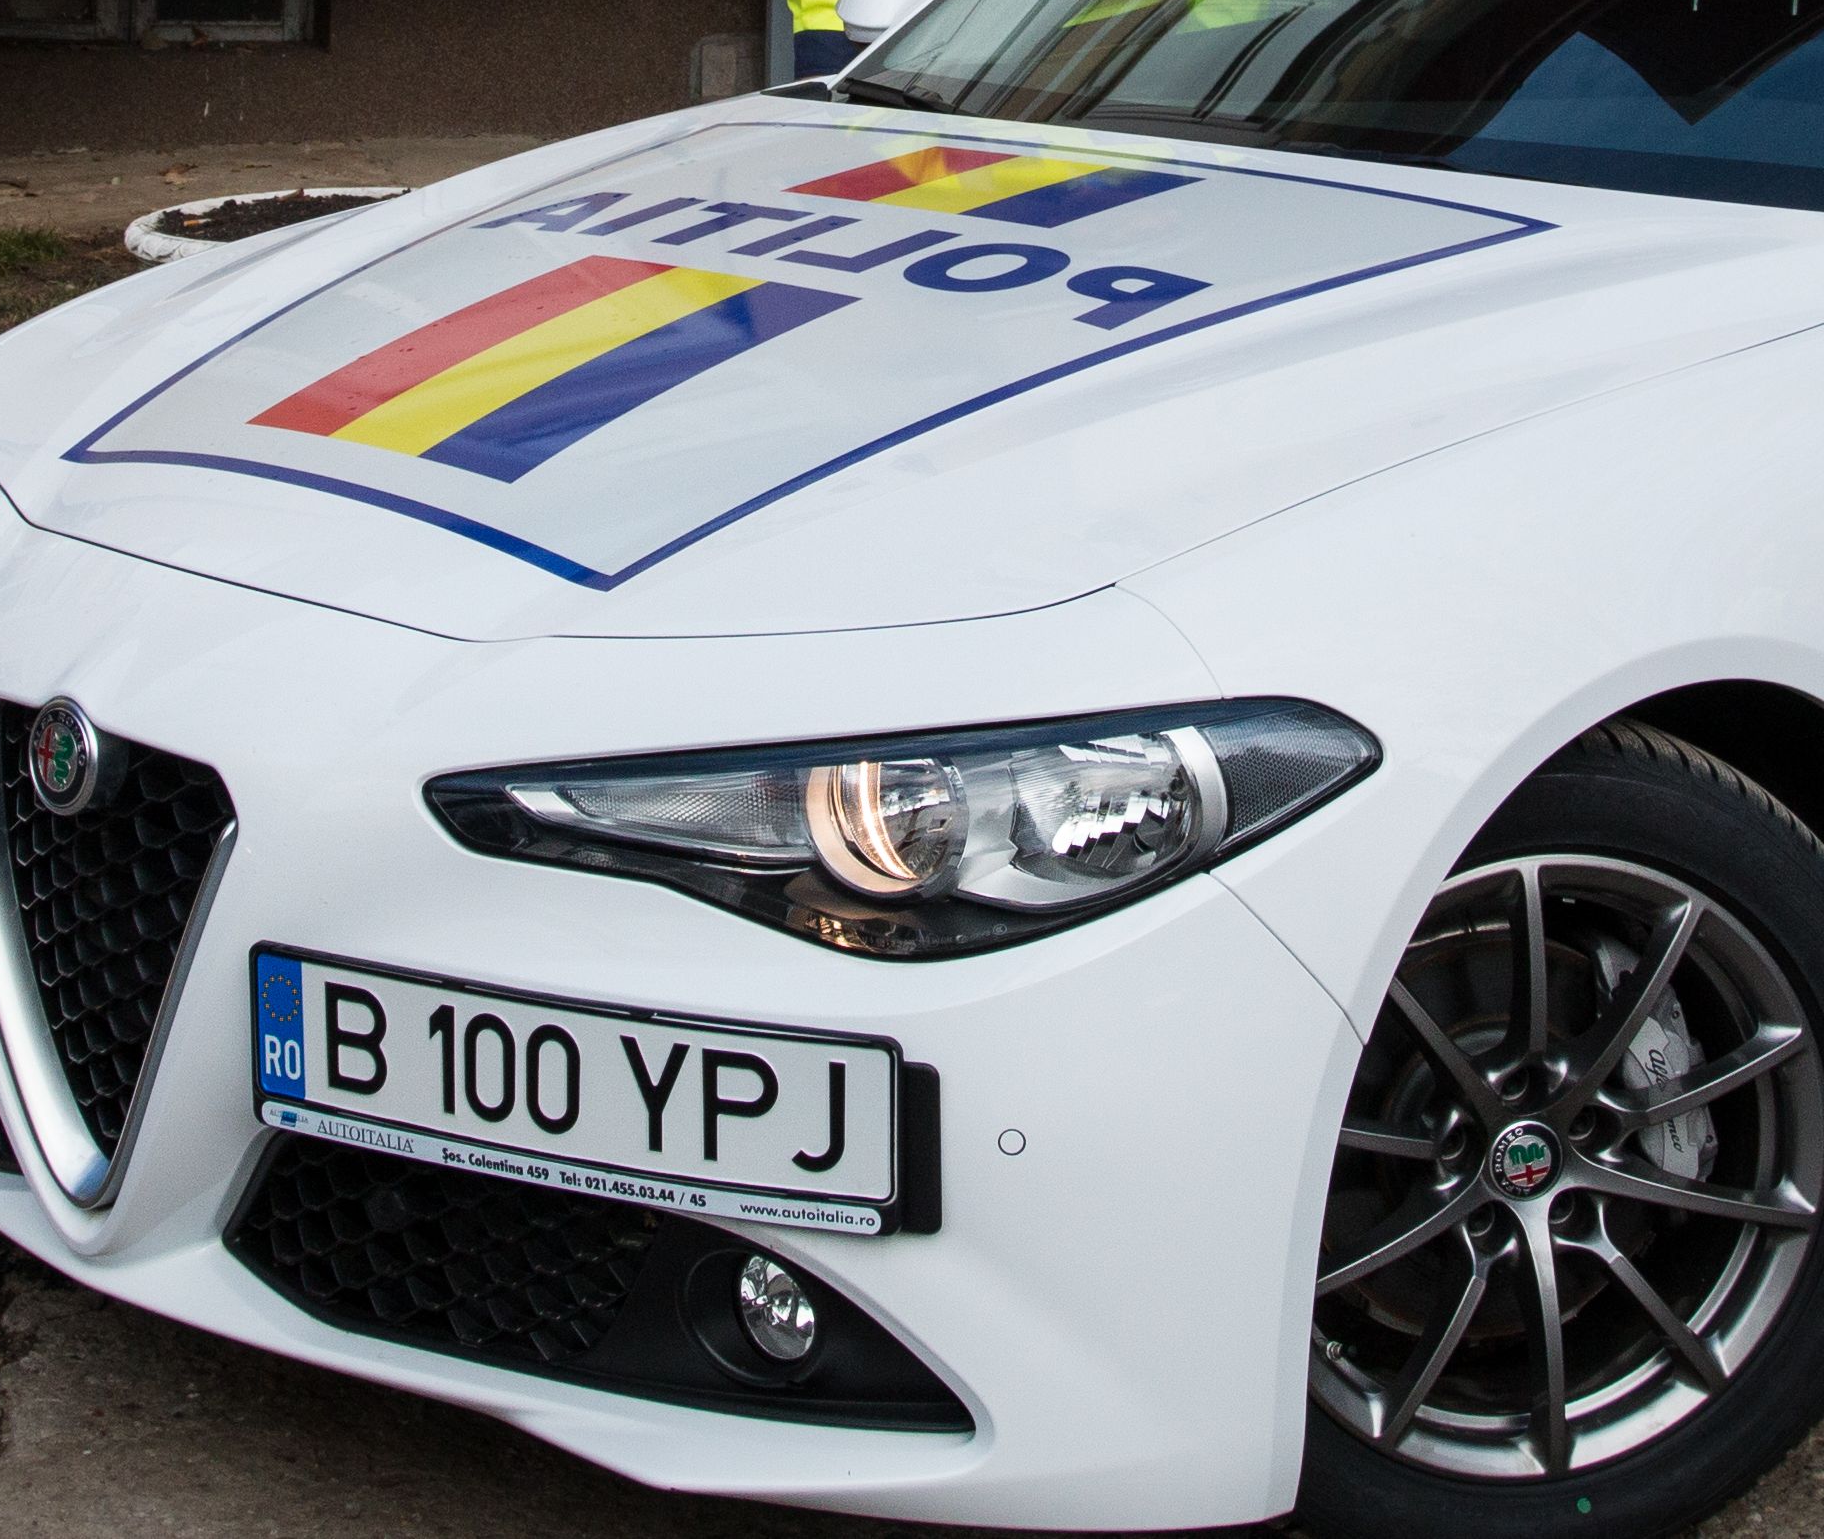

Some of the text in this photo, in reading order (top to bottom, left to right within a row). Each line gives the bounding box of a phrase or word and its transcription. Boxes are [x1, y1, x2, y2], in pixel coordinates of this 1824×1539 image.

[264, 981, 848, 1174] RO B 100 YPJ
[316, 1119, 415, 1154] AUTOITALIA
[468, 1152, 524, 1176] Colentina
[527, 1164, 549, 1181] 459
[559, 1171, 582, 1188] Tel:
[585, 1177, 675, 1203] 021.455.03.44
[689, 1193, 707, 1208] 45
[739, 1202, 876, 1228] www.autoitalia.ro
